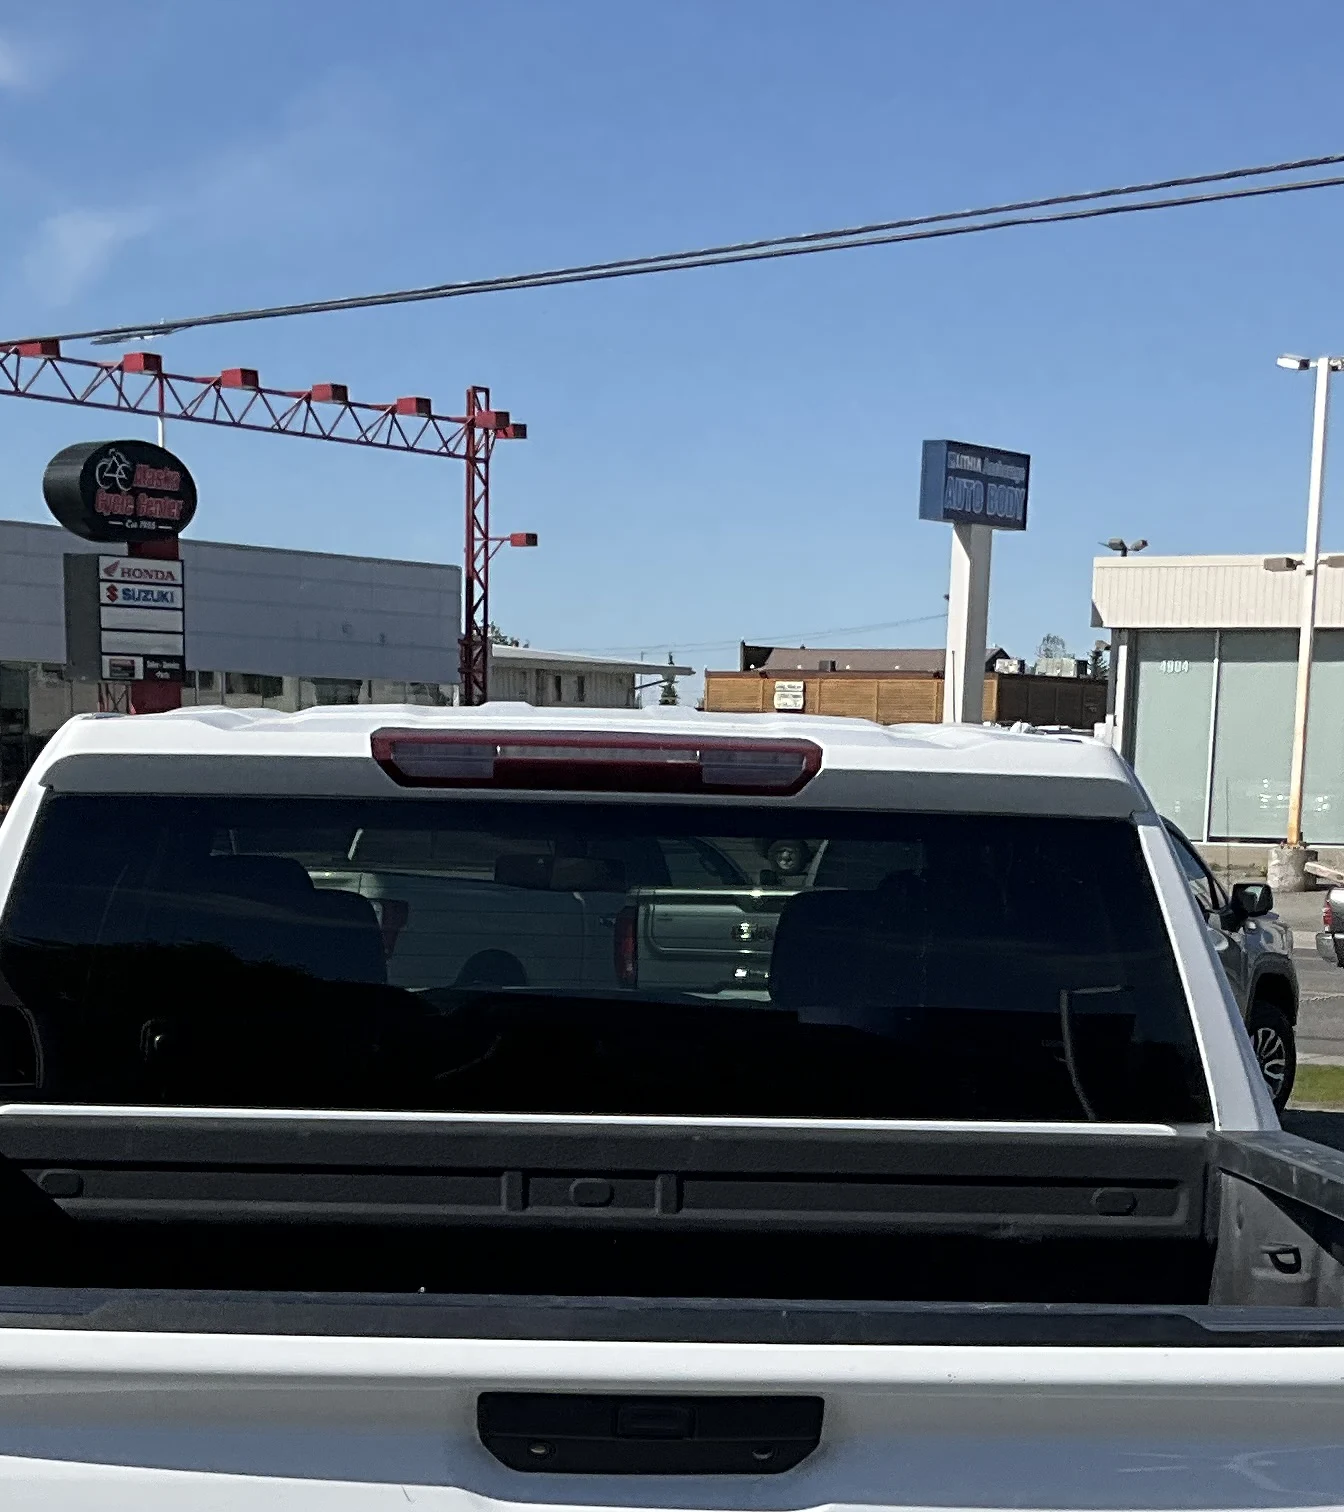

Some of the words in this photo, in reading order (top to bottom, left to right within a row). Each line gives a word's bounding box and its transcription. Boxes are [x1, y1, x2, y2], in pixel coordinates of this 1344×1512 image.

[944, 475, 985, 514] AUTO
[986, 482, 1026, 521] BODY
[120, 567, 176, 581] HONDA
[121, 587, 175, 603] SUZUKI
